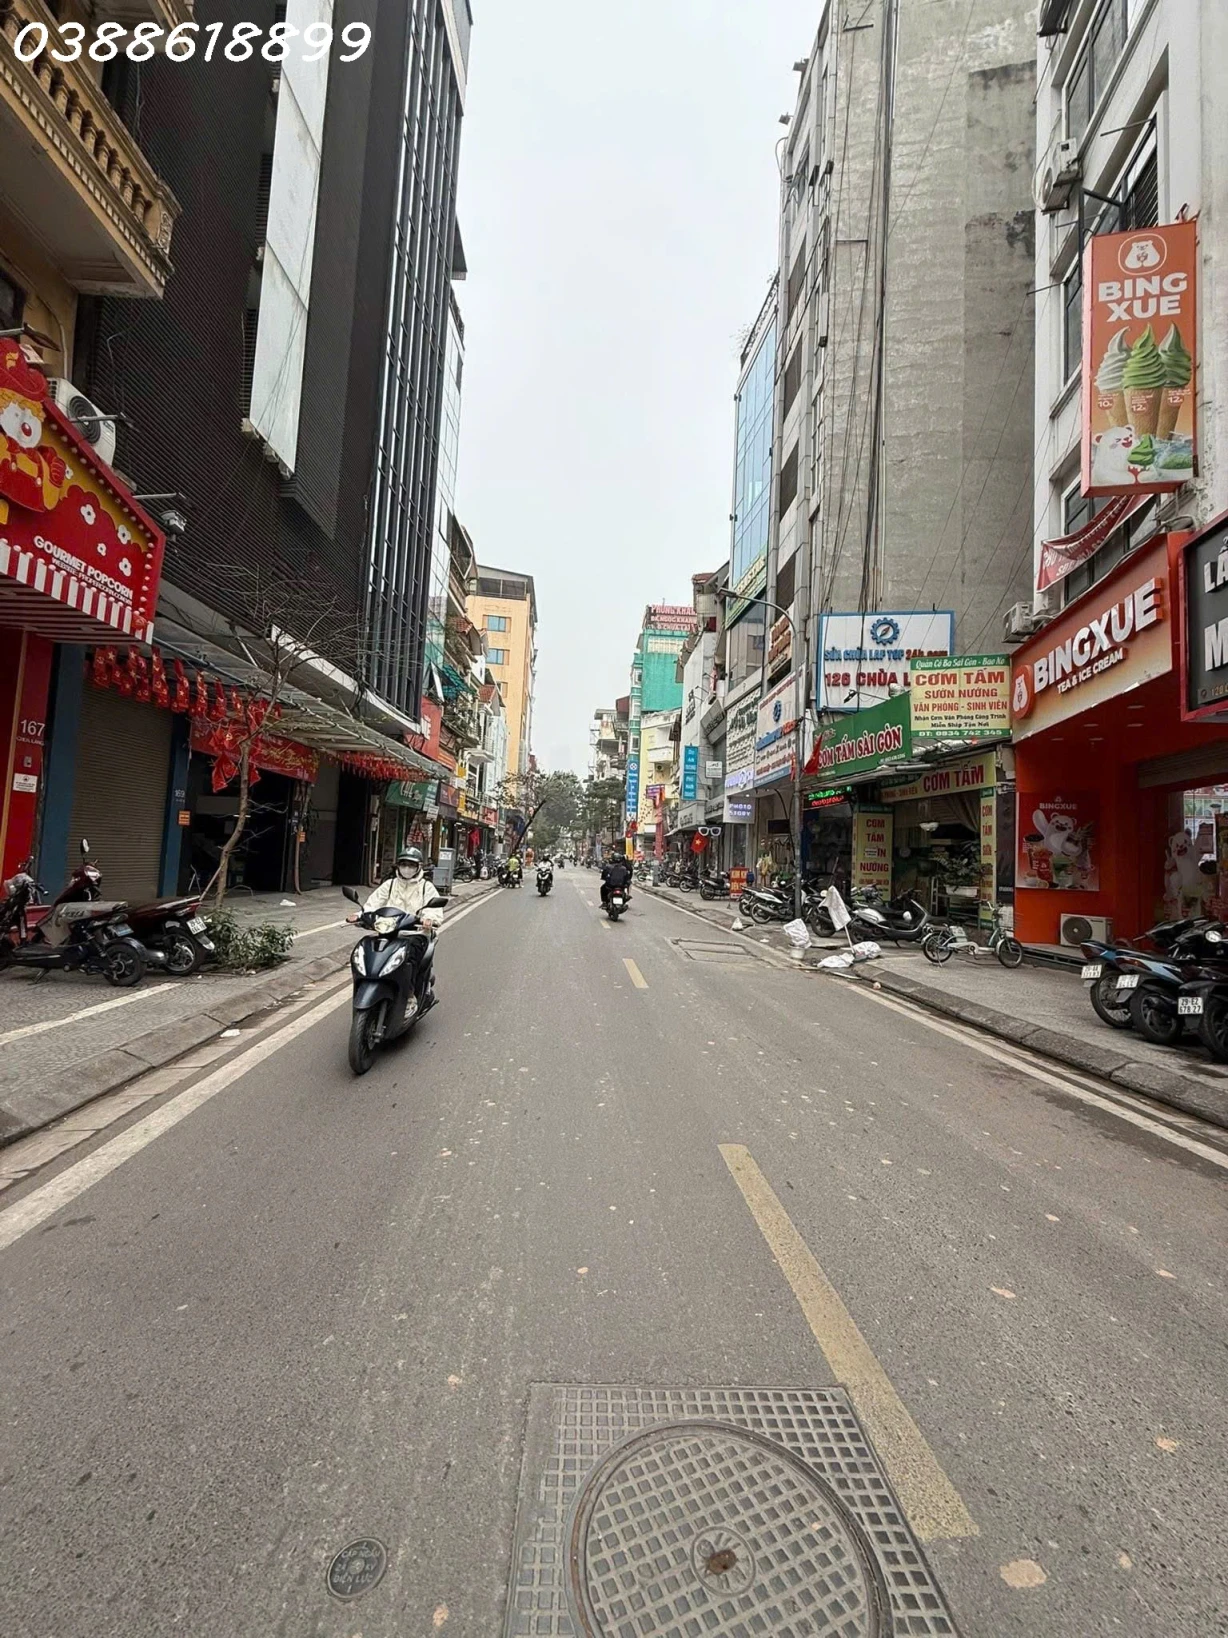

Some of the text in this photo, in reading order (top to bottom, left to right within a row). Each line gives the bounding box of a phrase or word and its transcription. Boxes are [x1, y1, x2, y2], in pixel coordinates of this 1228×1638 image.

[1099, 272, 1188, 302] BING
[1106, 295, 1181, 323] XUE
[33, 535, 133, 600] GOURMET POPCORN
[1034, 578, 1163, 694] BINGXUE
[868, 649, 886, 661] LAP
[887, 649, 904, 661] TOP
[825, 672, 850, 687] 126
[856, 668, 898, 687] CHÙA
[915, 667, 1005, 686] CƠM TẤM
[1057, 648, 1124, 694] TEA & ICE CREAM
[925, 686, 998, 699] SƯỜN NƯỚNG
[913, 702, 929, 712] VĂN
[931, 701, 959, 712] PHÒNG
[966, 701, 987, 711] SINH
[988, 699, 1008, 710] VIÊN
[20, 719, 46, 737] 167
[835, 733, 856, 764] TẤM
[856, 730, 876, 758] SÀI
[877, 722, 903, 754] GÒN
[923, 761, 985, 793] CƠM TẤM
[1039, 802, 1077, 810] BINGXUE
